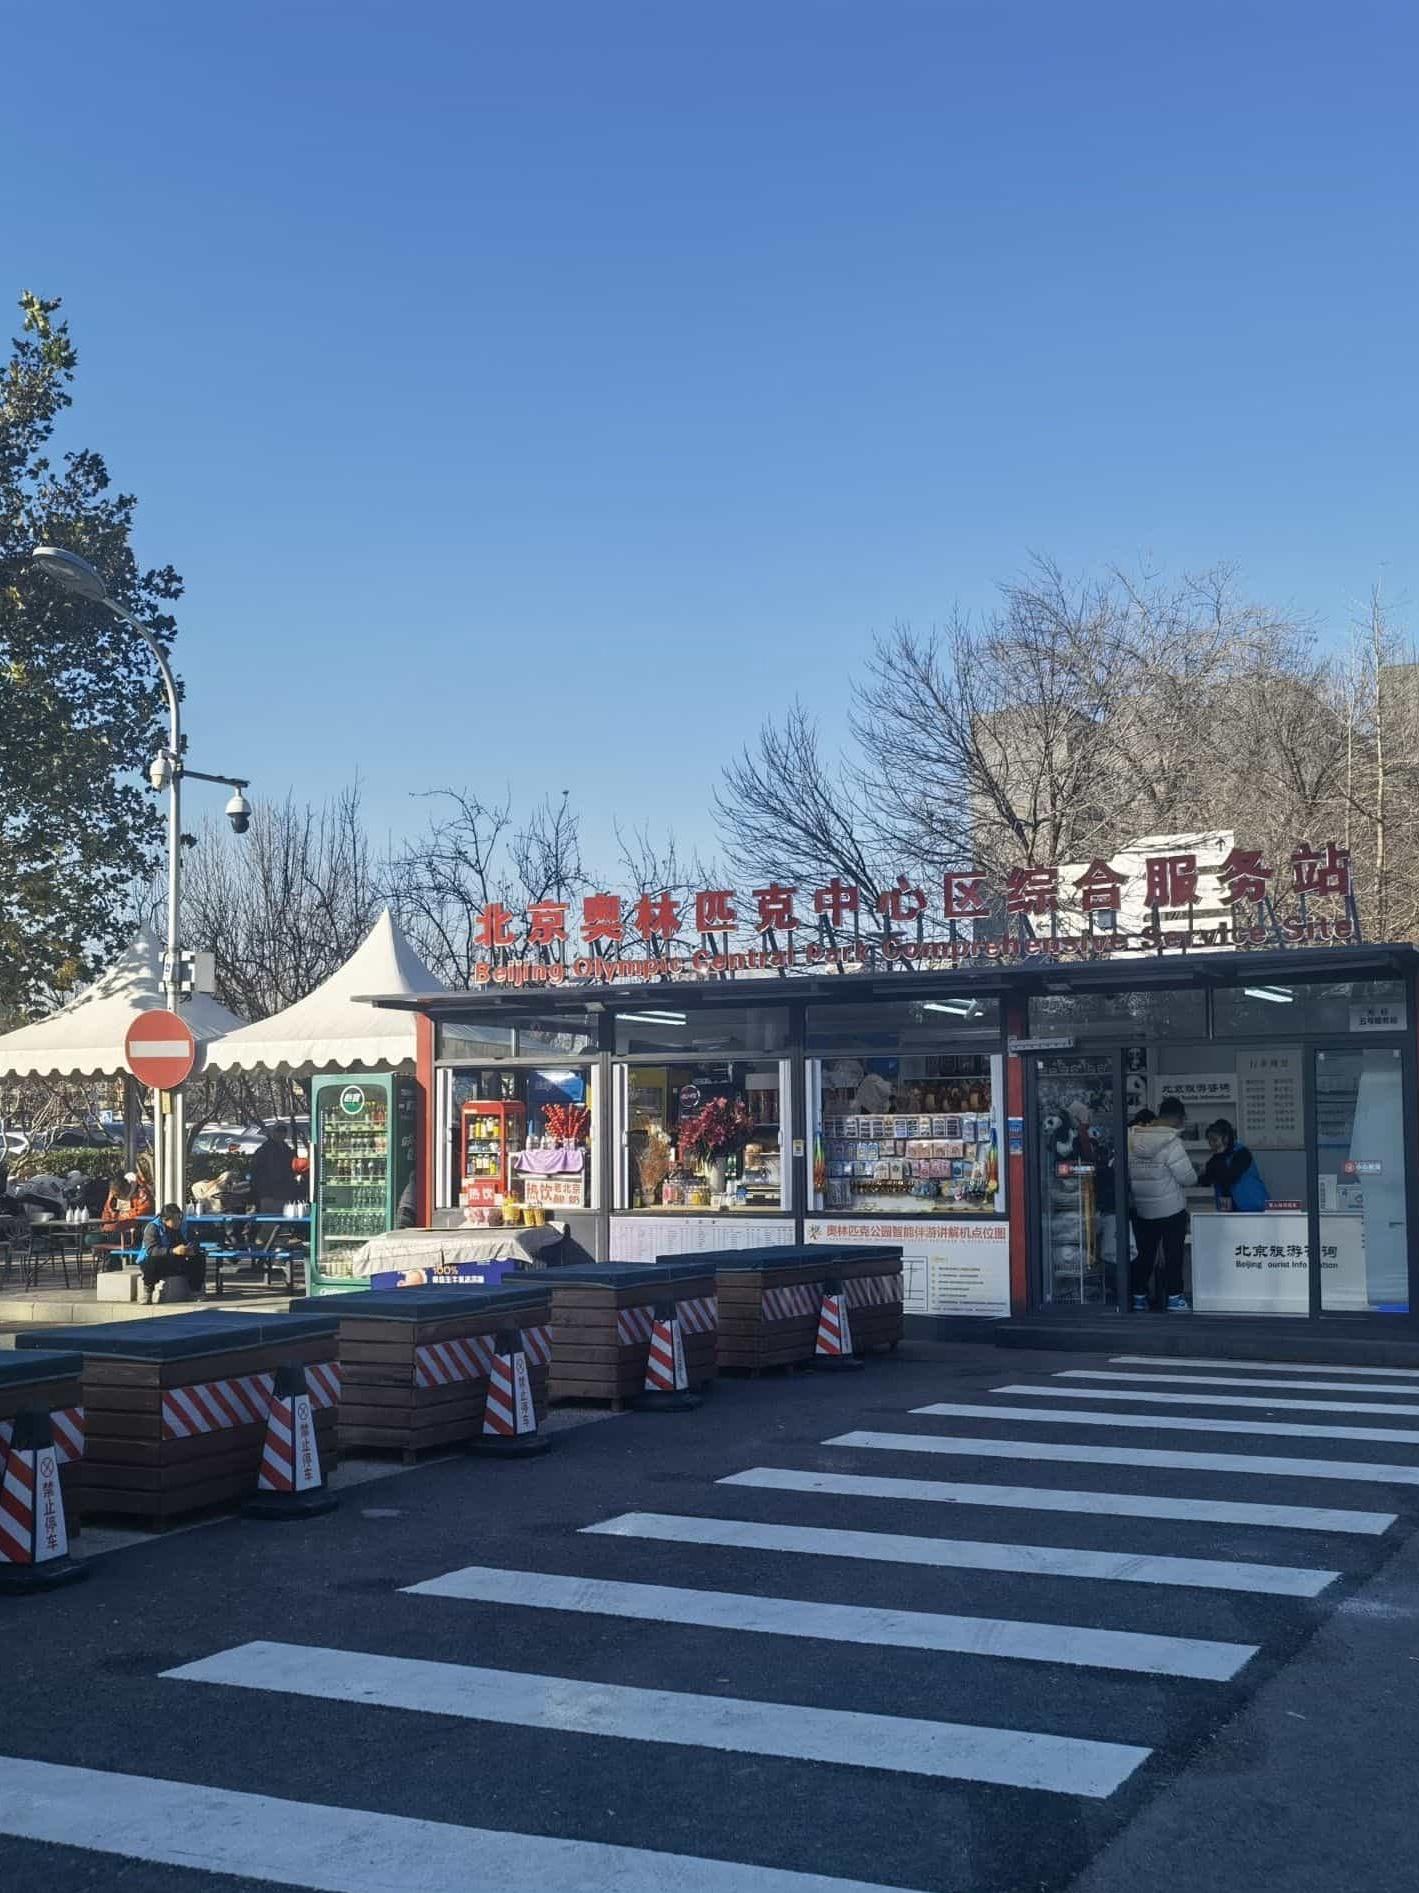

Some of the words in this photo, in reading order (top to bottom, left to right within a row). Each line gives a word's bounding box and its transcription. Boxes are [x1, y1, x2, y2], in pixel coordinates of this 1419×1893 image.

[474, 843, 1353, 947] 北京奥林匹克中心区综合服务站
[474, 959, 565, 985] Beijing
[573, 955, 681, 982] Olympic
[692, 945, 794, 972] Central
[806, 939, 872, 963] Park
[881, 932, 1128, 961] Comprehensive
[1141, 921, 1268, 950] Service
[1281, 916, 1355, 943] Site
[1235, 1260, 1262, 1270] Beijing
[518, 1376, 529, 1427] 禁止停车
[300, 1424, 314, 1480] 禁止停车
[42, 1481, 58, 1551] 禁止停车
